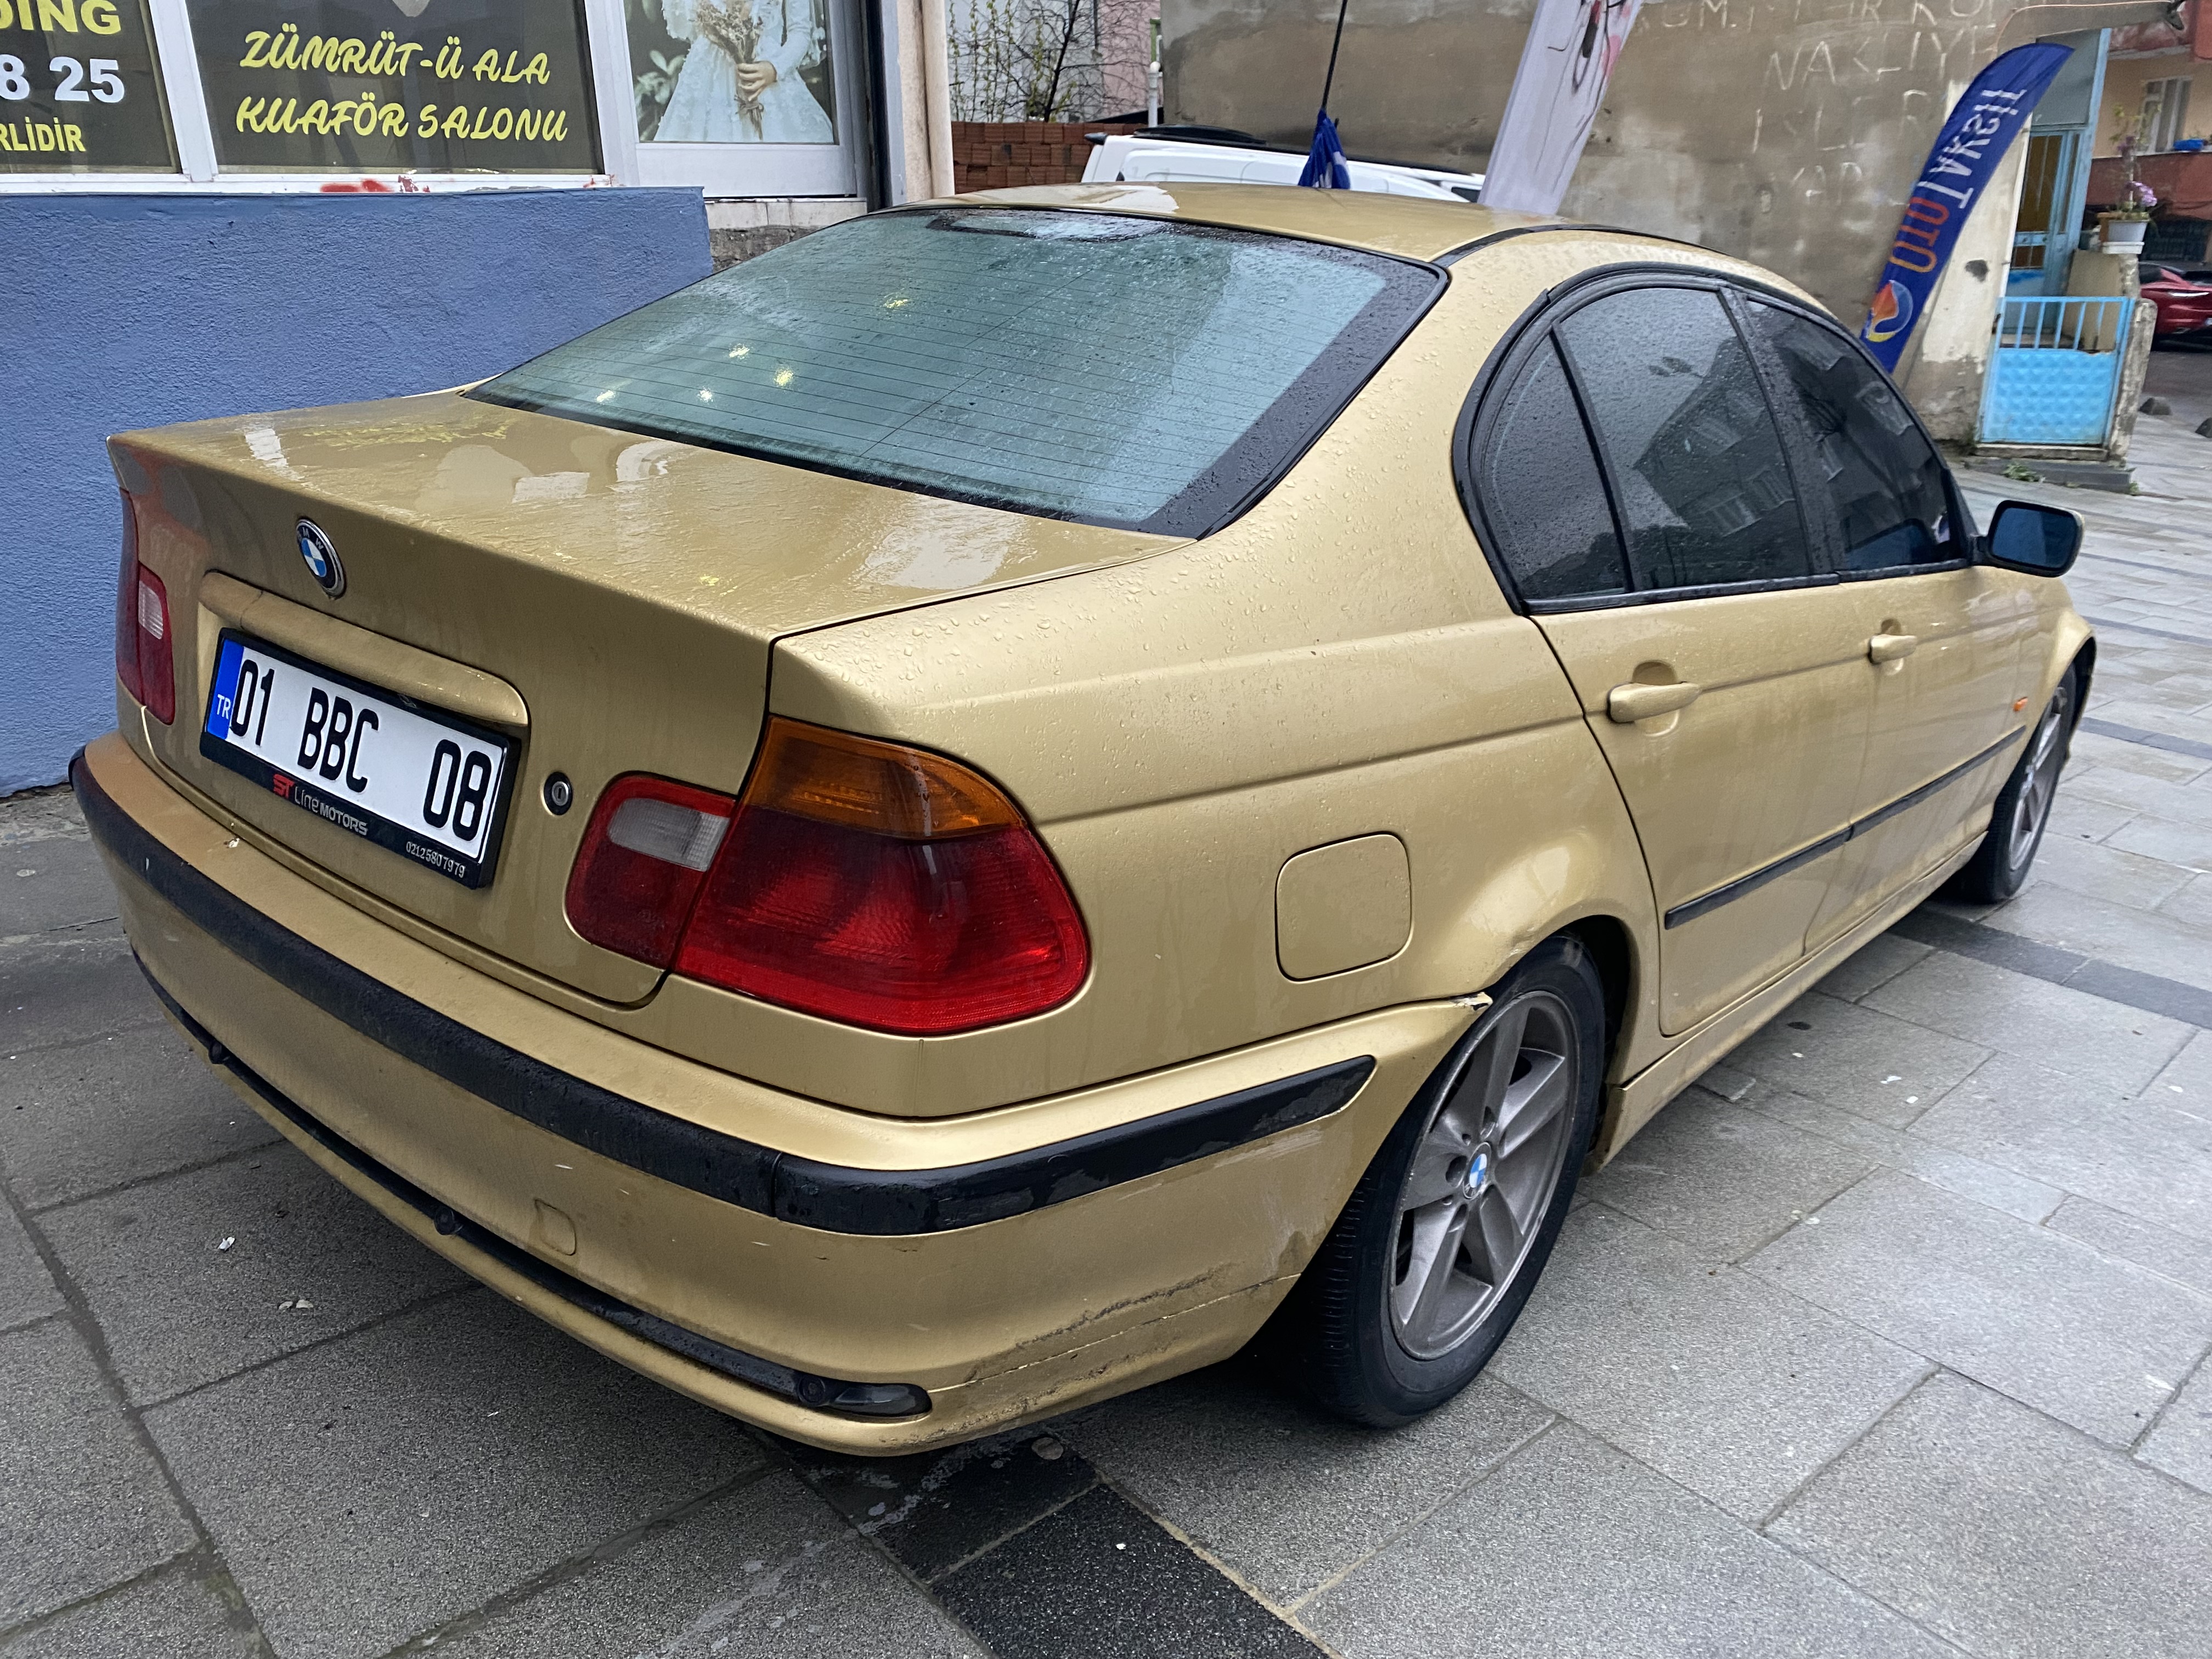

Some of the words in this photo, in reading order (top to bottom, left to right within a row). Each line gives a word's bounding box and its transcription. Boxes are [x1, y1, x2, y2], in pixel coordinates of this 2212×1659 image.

[49, 56, 125, 103] 25
[472, 48, 550, 84] ALA
[236, 91, 409, 137] KUAFÖR
[417, 104, 568, 142] SALONU
[297, 527, 324, 550] BMW
[217, 694, 230, 720] TR
[229, 659, 276, 747] 01
[297, 687, 379, 793] BBC
[423, 739, 492, 842] 08
[405, 840, 467, 879] 02125807979
